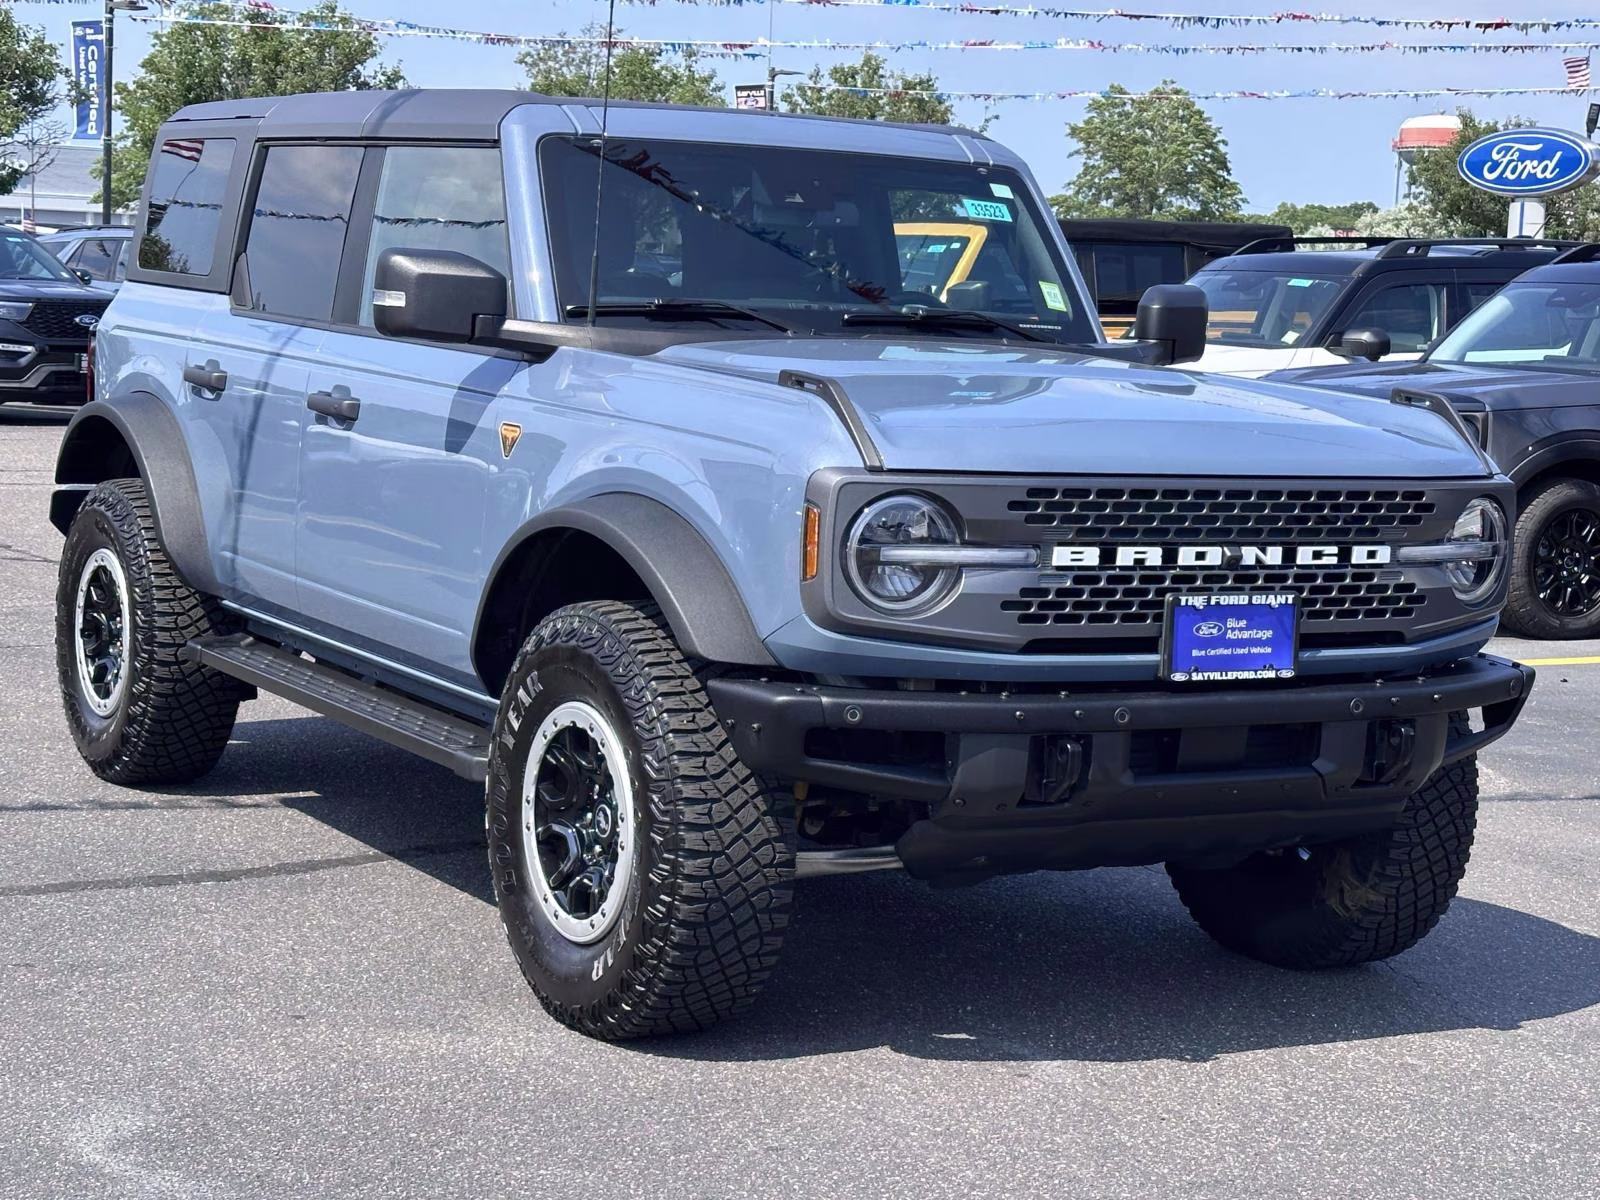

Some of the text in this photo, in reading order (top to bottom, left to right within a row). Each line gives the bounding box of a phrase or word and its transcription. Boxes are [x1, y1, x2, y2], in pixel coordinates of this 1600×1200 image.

[1483, 142, 1563, 180] Ford
[970, 203, 1005, 219] 33523
[1052, 546, 1391, 566] BRONCO
[1179, 594, 1295, 606] THE FORD GIANT
[1226, 618, 1247, 628] Blue
[1226, 629, 1273, 640] Advantage
[1192, 646, 1272, 657] Blue Certified Used Vehicle
[1191, 670, 1276, 681] SAYVILLEFORD.COM
